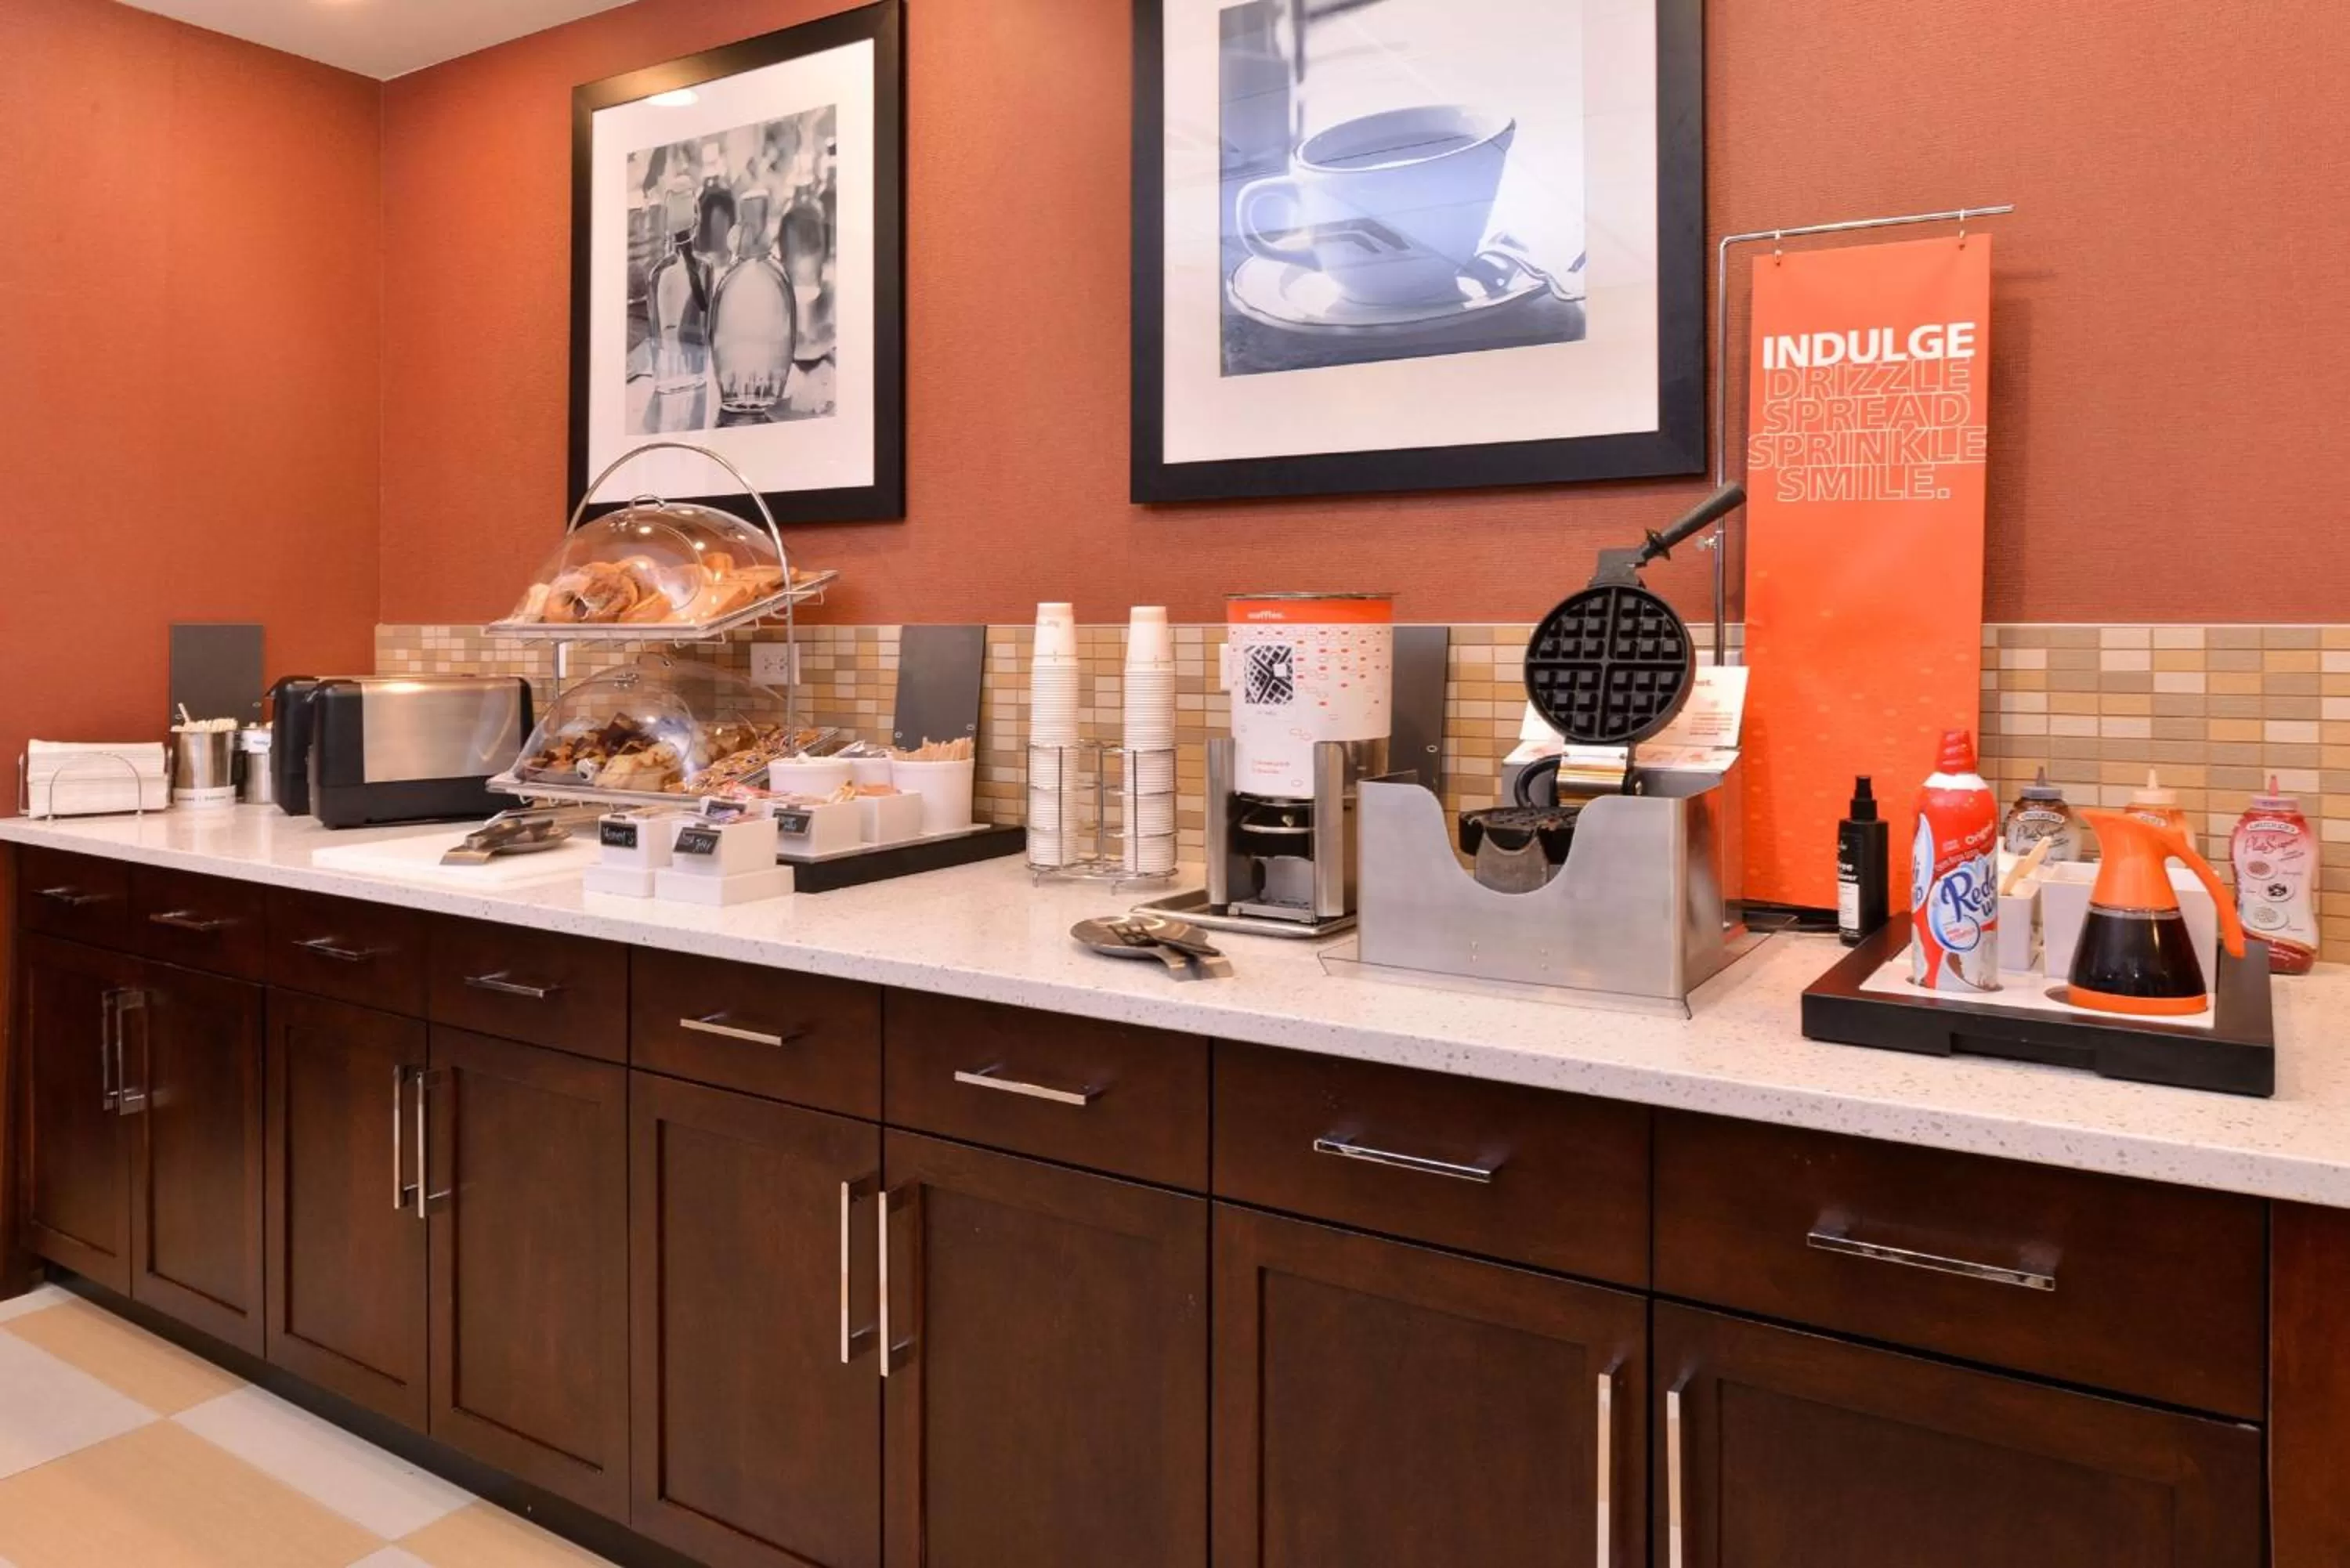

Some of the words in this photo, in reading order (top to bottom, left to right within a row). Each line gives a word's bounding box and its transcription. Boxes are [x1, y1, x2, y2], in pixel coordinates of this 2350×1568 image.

[1762, 322, 1976, 369] INDULGE
[1766, 356, 1970, 401] DRIZZLE
[1763, 391, 1970, 435] SPREAD
[1748, 425, 1987, 471] SPRINKLE
[1776, 464, 1950, 503] SMILE.
